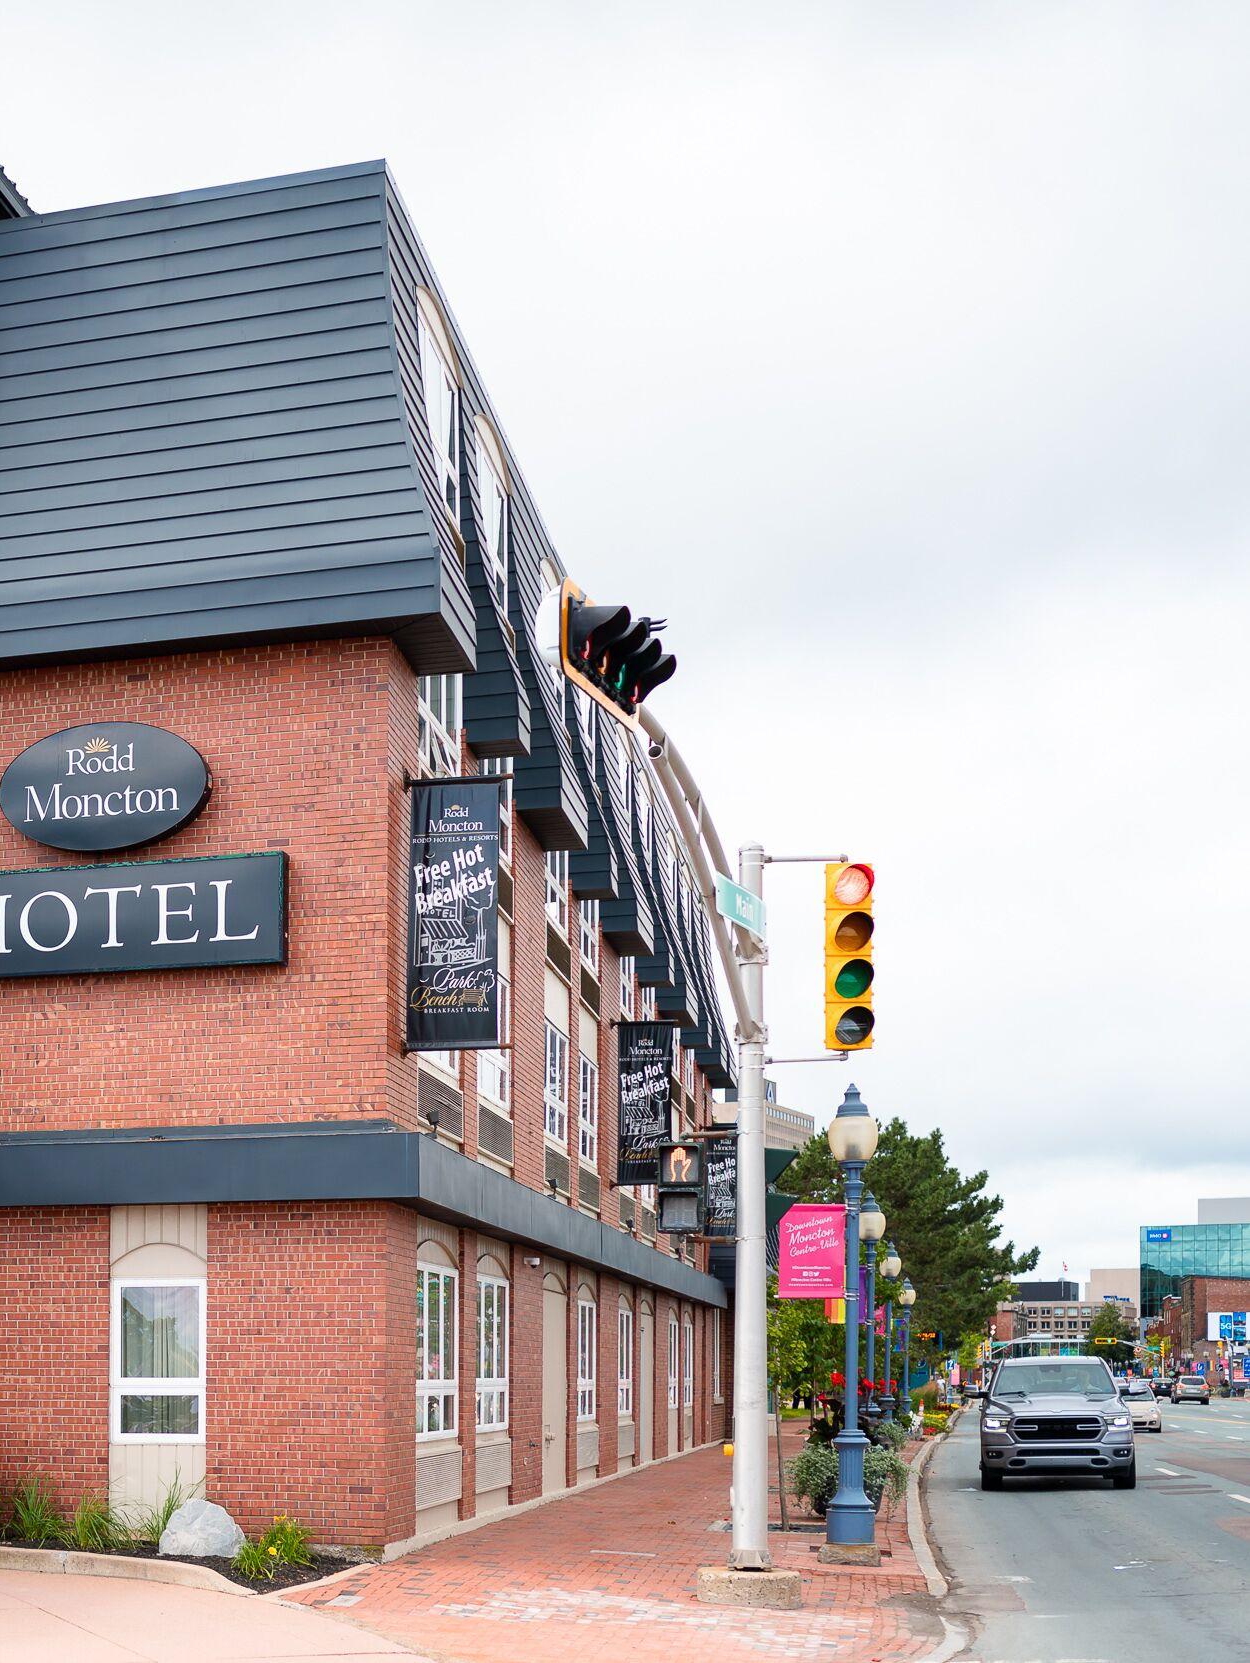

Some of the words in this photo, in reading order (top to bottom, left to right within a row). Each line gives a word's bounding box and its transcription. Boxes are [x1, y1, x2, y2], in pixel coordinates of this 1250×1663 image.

[65, 742, 136, 777] Rodd
[23, 781, 181, 823] Moncton
[444, 806, 469, 818] Rodd
[428, 819, 483, 833] Moncton
[433, 835, 461, 843] HOTELS
[413, 860, 451, 887] Free
[452, 843, 484, 872] Hot
[415, 867, 493, 914] Breakfast
[430, 967, 475, 993] Park
[410, 985, 459, 1012] Bench
[630, 1046, 663, 1055] Moncton
[638, 1039, 654, 1047] Rodd
[620, 1071, 644, 1088] Free
[644, 1062, 664, 1078] Hot
[621, 1076, 670, 1104] Breakfast
[707, 1161, 725, 1174] Free
[725, 1157, 736, 1169] Ho
[707, 1168, 736, 1185] Breakfa
[785, 1216, 833, 1233] Downtown
[789, 1227, 835, 1246] Moncton
[789, 1237, 839, 1257] Centre-Ville
[1220, 1322, 1232, 1330] 5G
